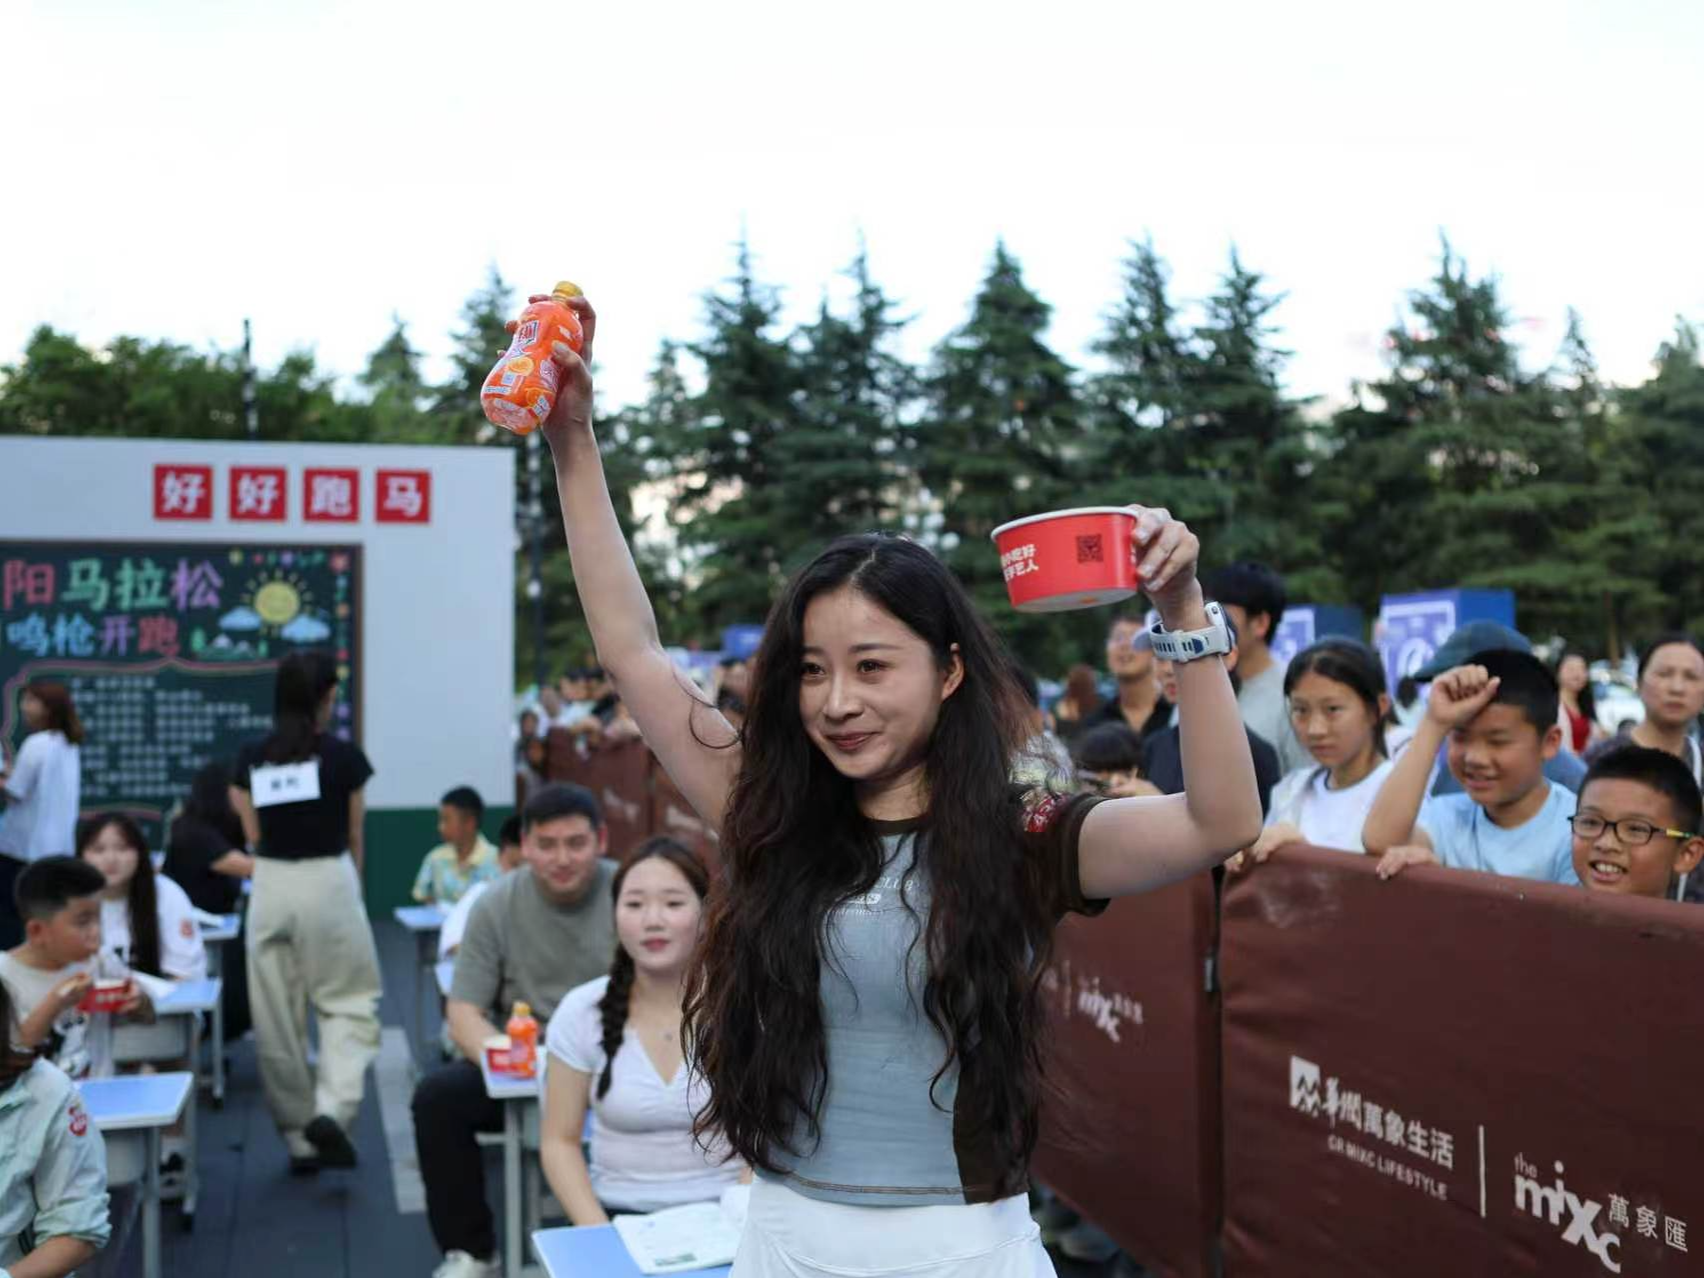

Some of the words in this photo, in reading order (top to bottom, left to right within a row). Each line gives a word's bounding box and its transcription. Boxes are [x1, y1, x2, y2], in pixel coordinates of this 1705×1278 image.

[161, 470, 423, 517] 好好跑马
[3, 557, 224, 612] 阳马拉松
[6, 611, 180, 657] 鸣枪开跑
[1377, 1155, 1448, 1201] LIFESTYLE
[1514, 1152, 1538, 1179] the
[1608, 1193, 1688, 1252] 萬象匯
